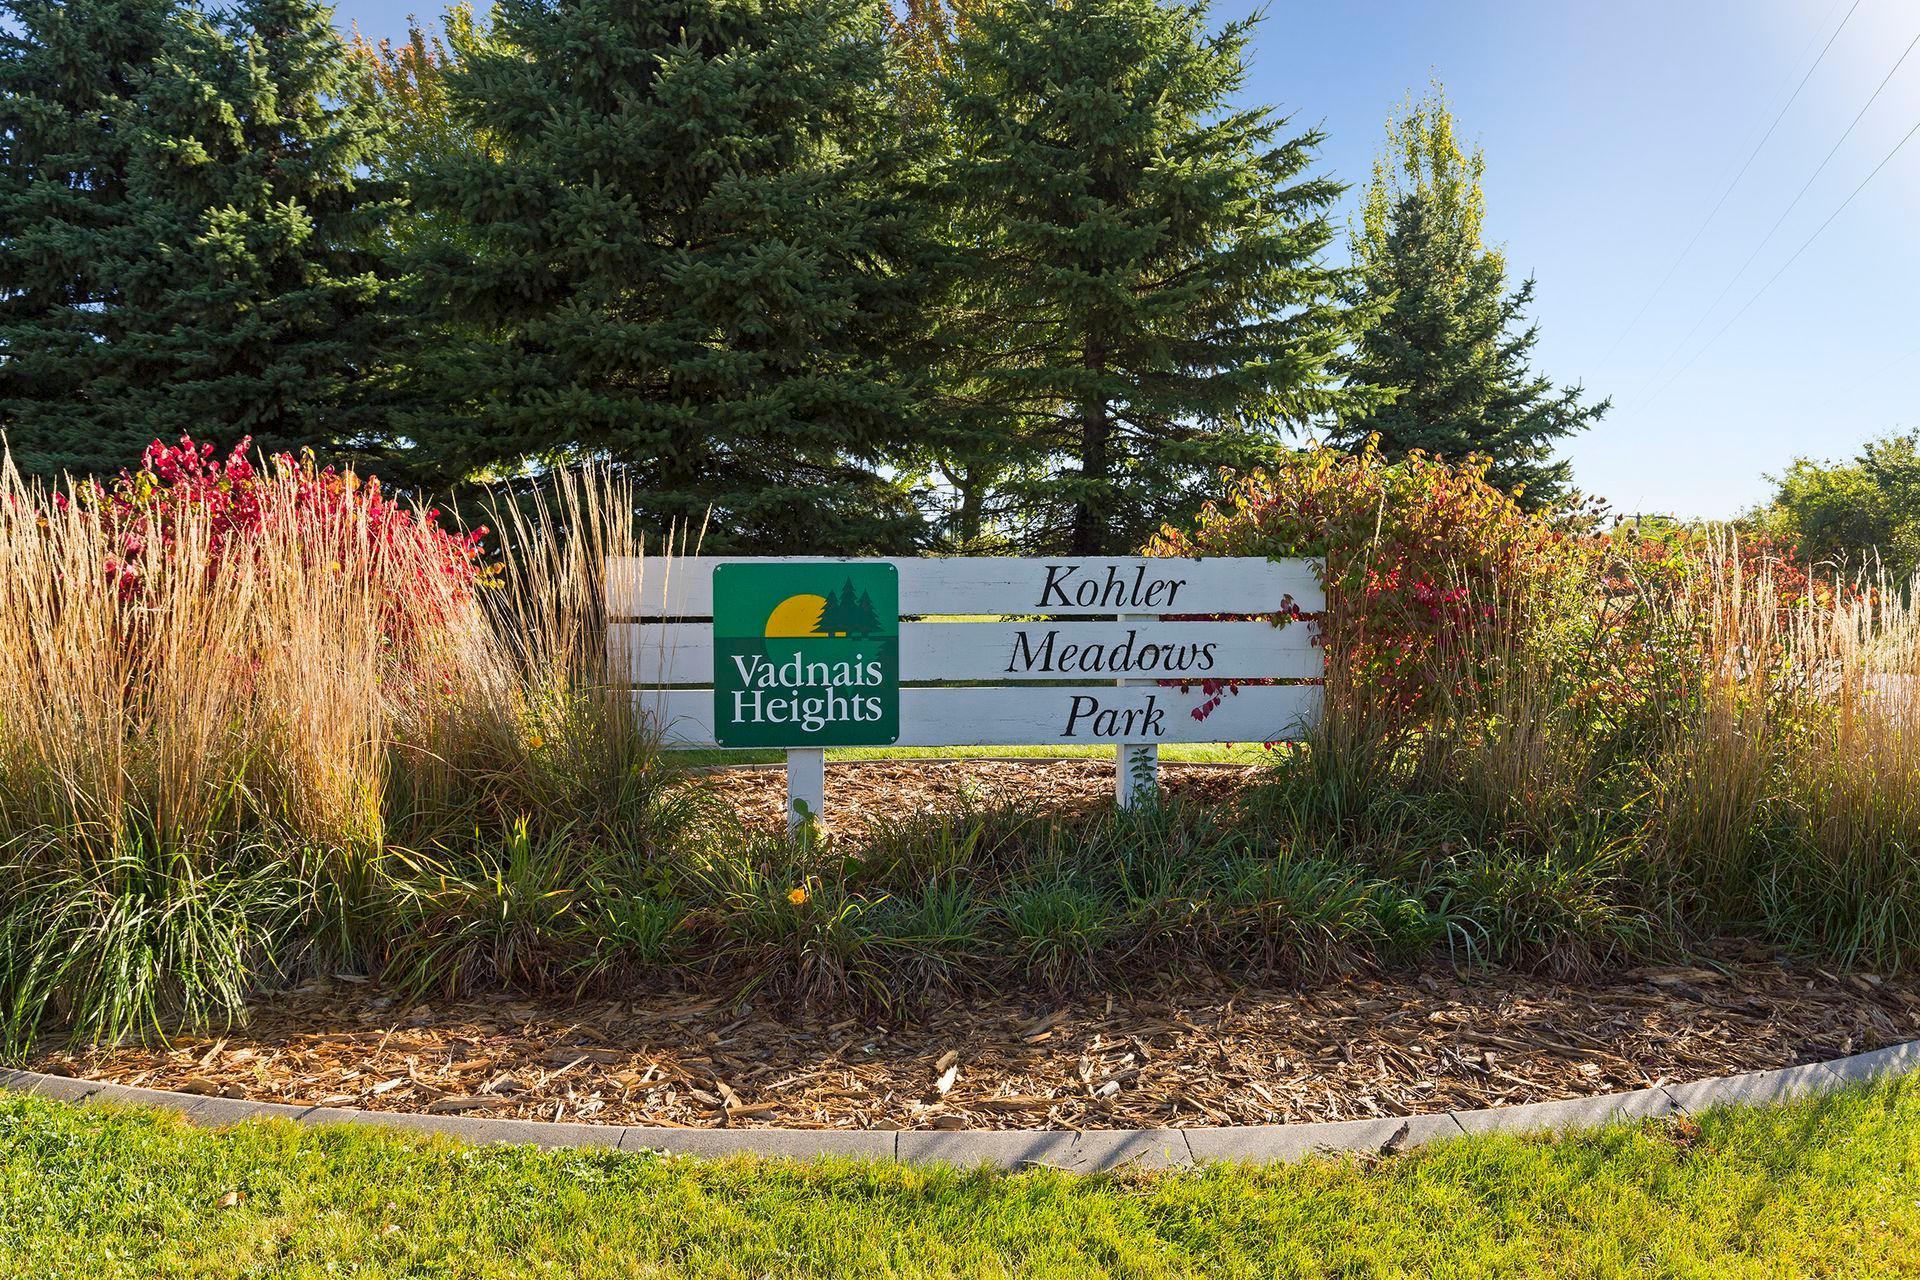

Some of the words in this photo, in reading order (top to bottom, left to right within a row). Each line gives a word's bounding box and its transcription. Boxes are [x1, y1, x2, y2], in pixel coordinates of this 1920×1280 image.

[1035, 565, 1187, 608] Kohler
[731, 651, 883, 687] Vadnais
[1004, 629, 1217, 673] Meadows
[731, 686, 883, 732] Heights
[1060, 694, 1166, 737] Park
